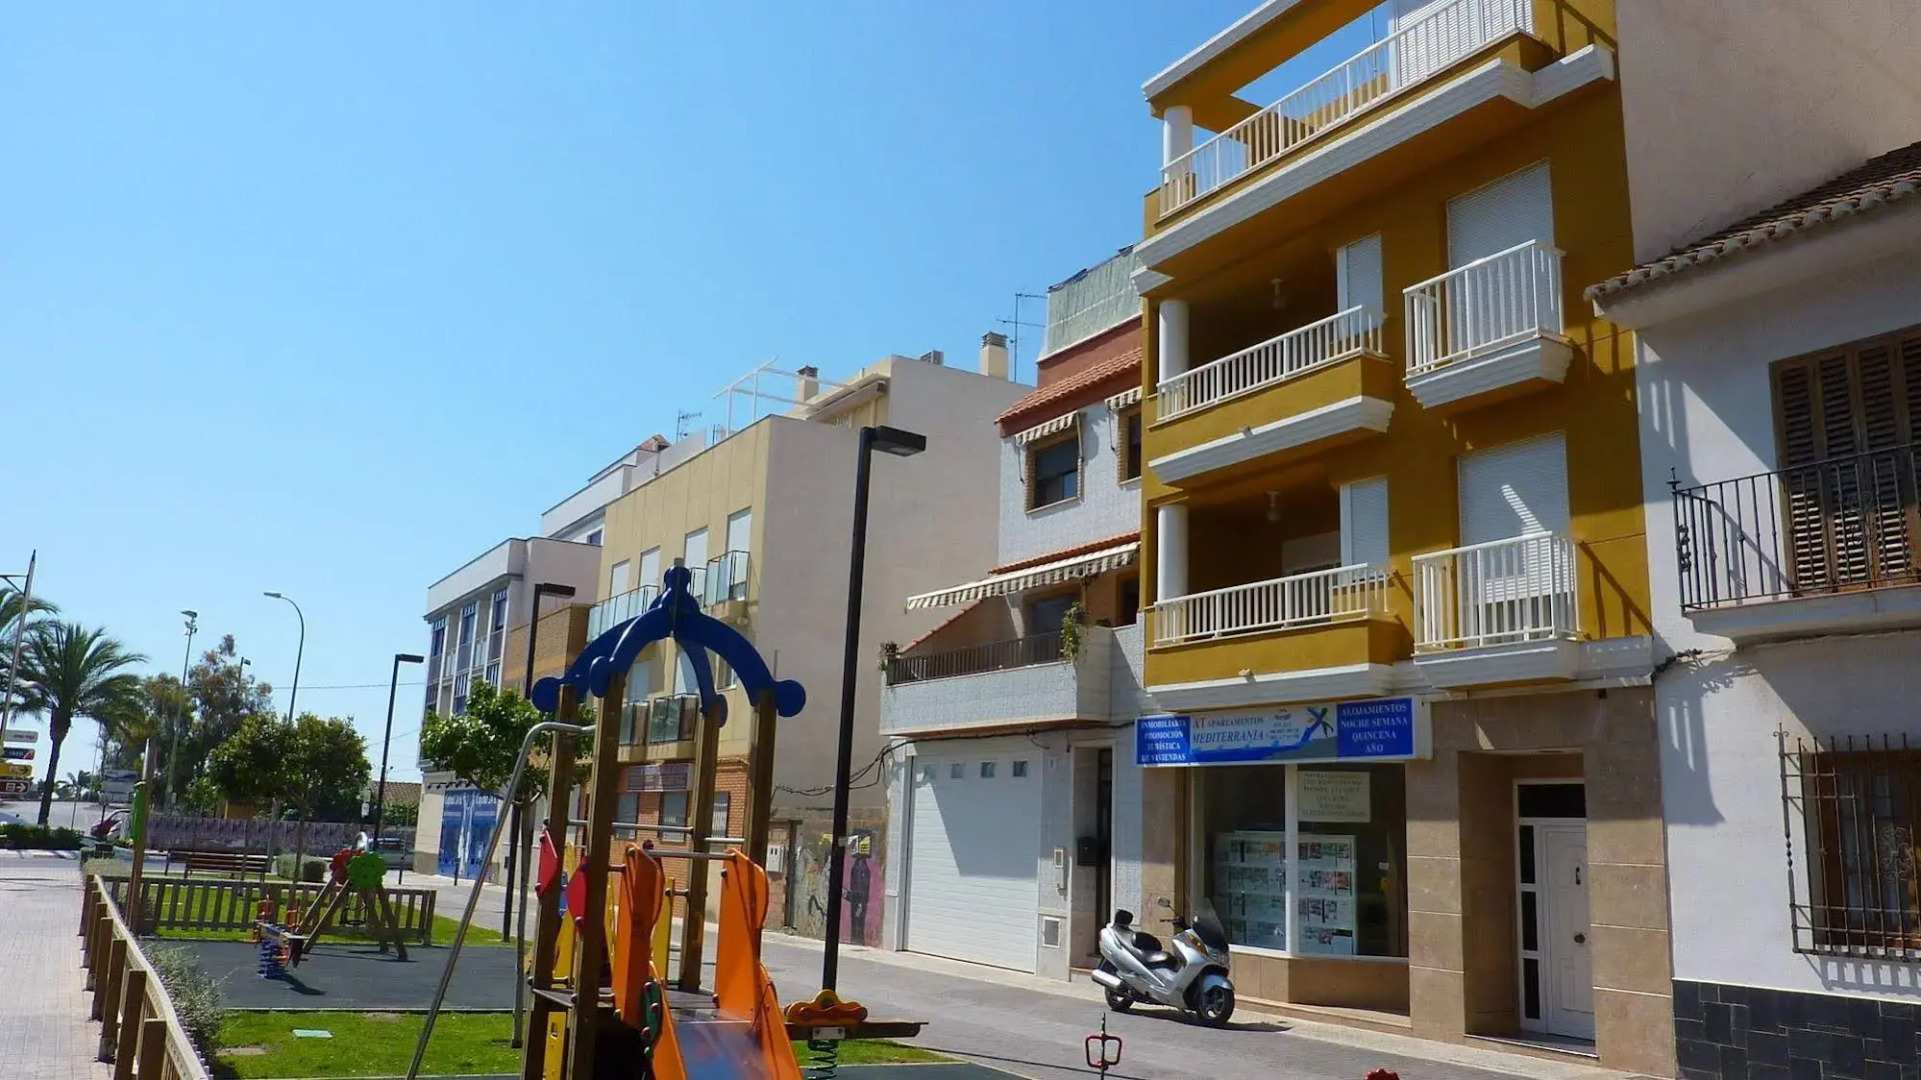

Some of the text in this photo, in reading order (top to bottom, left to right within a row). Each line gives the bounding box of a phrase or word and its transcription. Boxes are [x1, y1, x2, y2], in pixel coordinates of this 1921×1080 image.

[1342, 703, 1407, 716] ALOJAMIENTOS
[1141, 719, 1186, 729] INMOBILIARIA
[1341, 716, 1408, 729] NOCHE SEMANA
[1352, 730, 1397, 743] QUINCENA
[1366, 742, 1384, 754] AÑO
